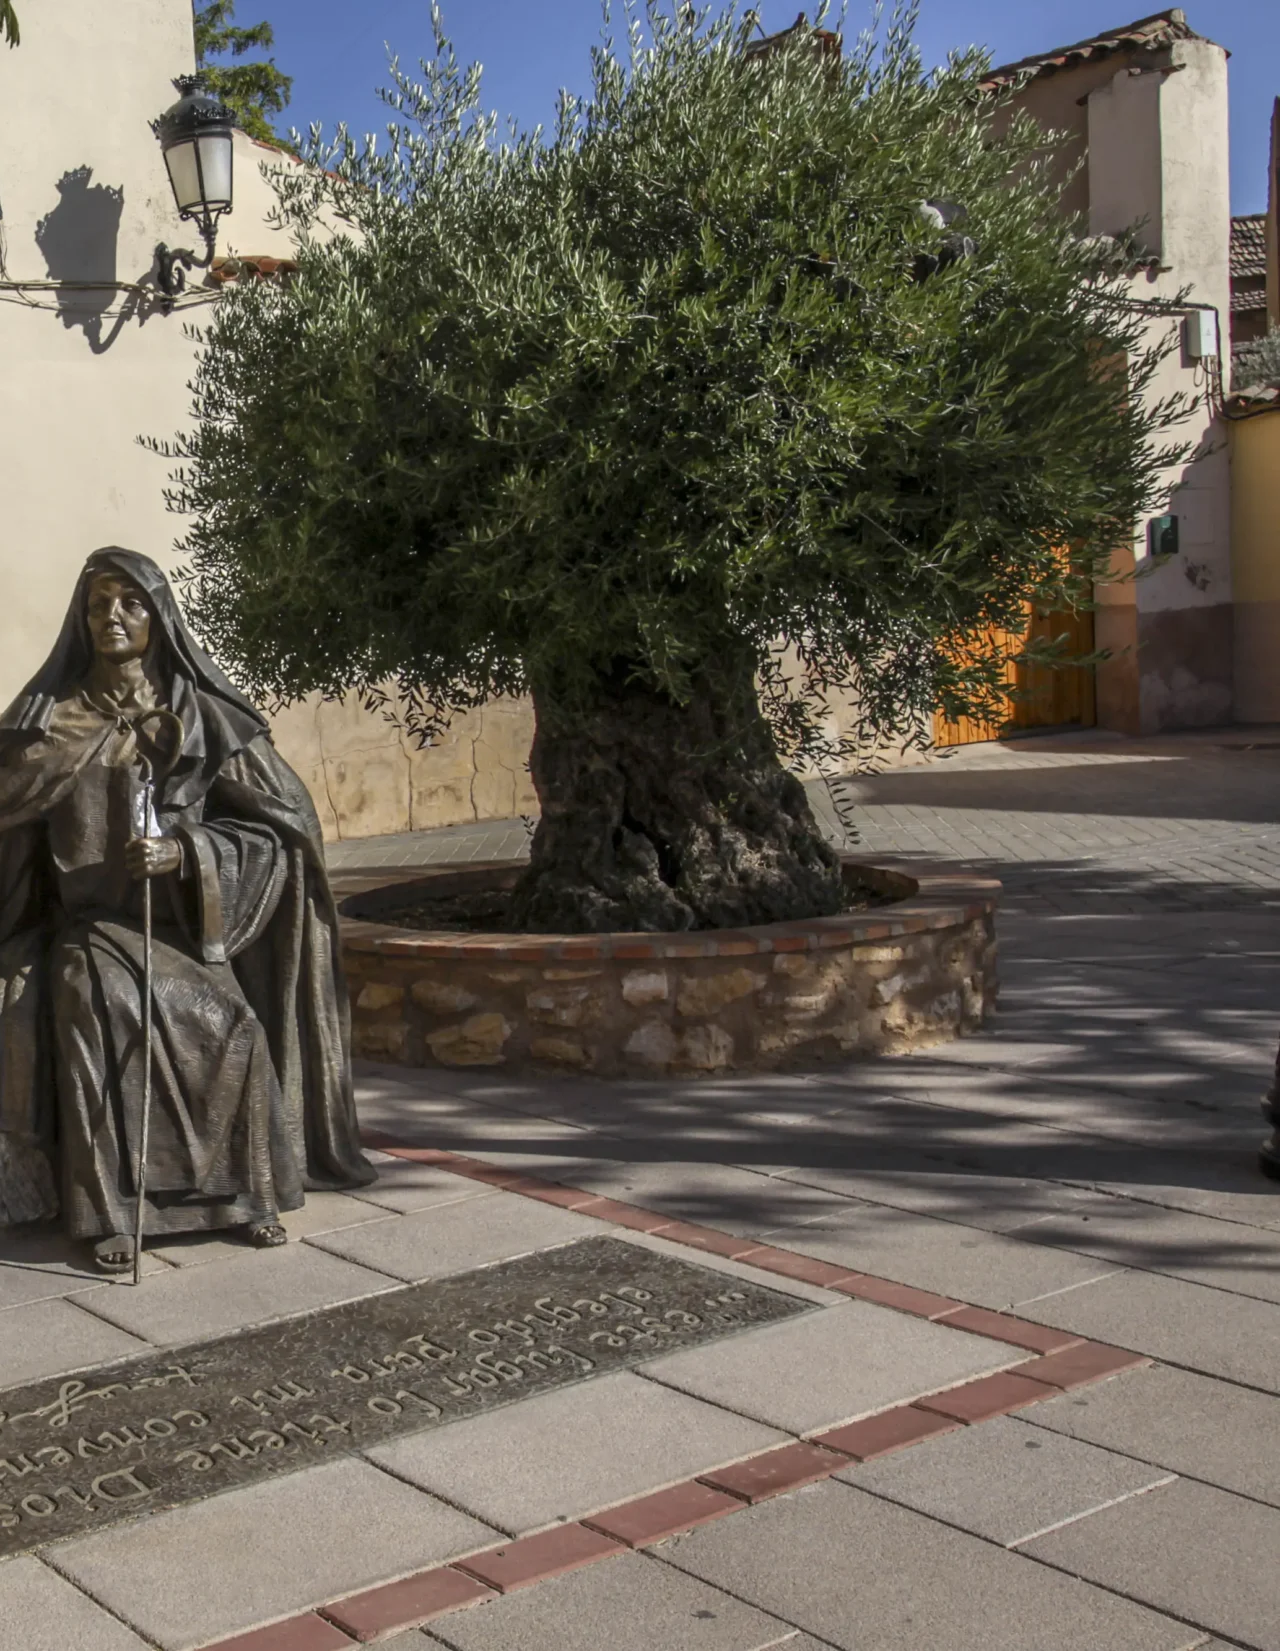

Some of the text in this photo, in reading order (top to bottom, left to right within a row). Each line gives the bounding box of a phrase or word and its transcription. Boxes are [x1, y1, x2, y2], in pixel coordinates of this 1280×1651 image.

[466, 1286, 651, 1345] elegido
[328, 1334, 462, 1384] para
[440, 1345, 590, 1395] lugar
[226, 1380, 313, 1415] mi
[358, 1389, 440, 1417] lo
[169, 1413, 351, 1470] tiene
